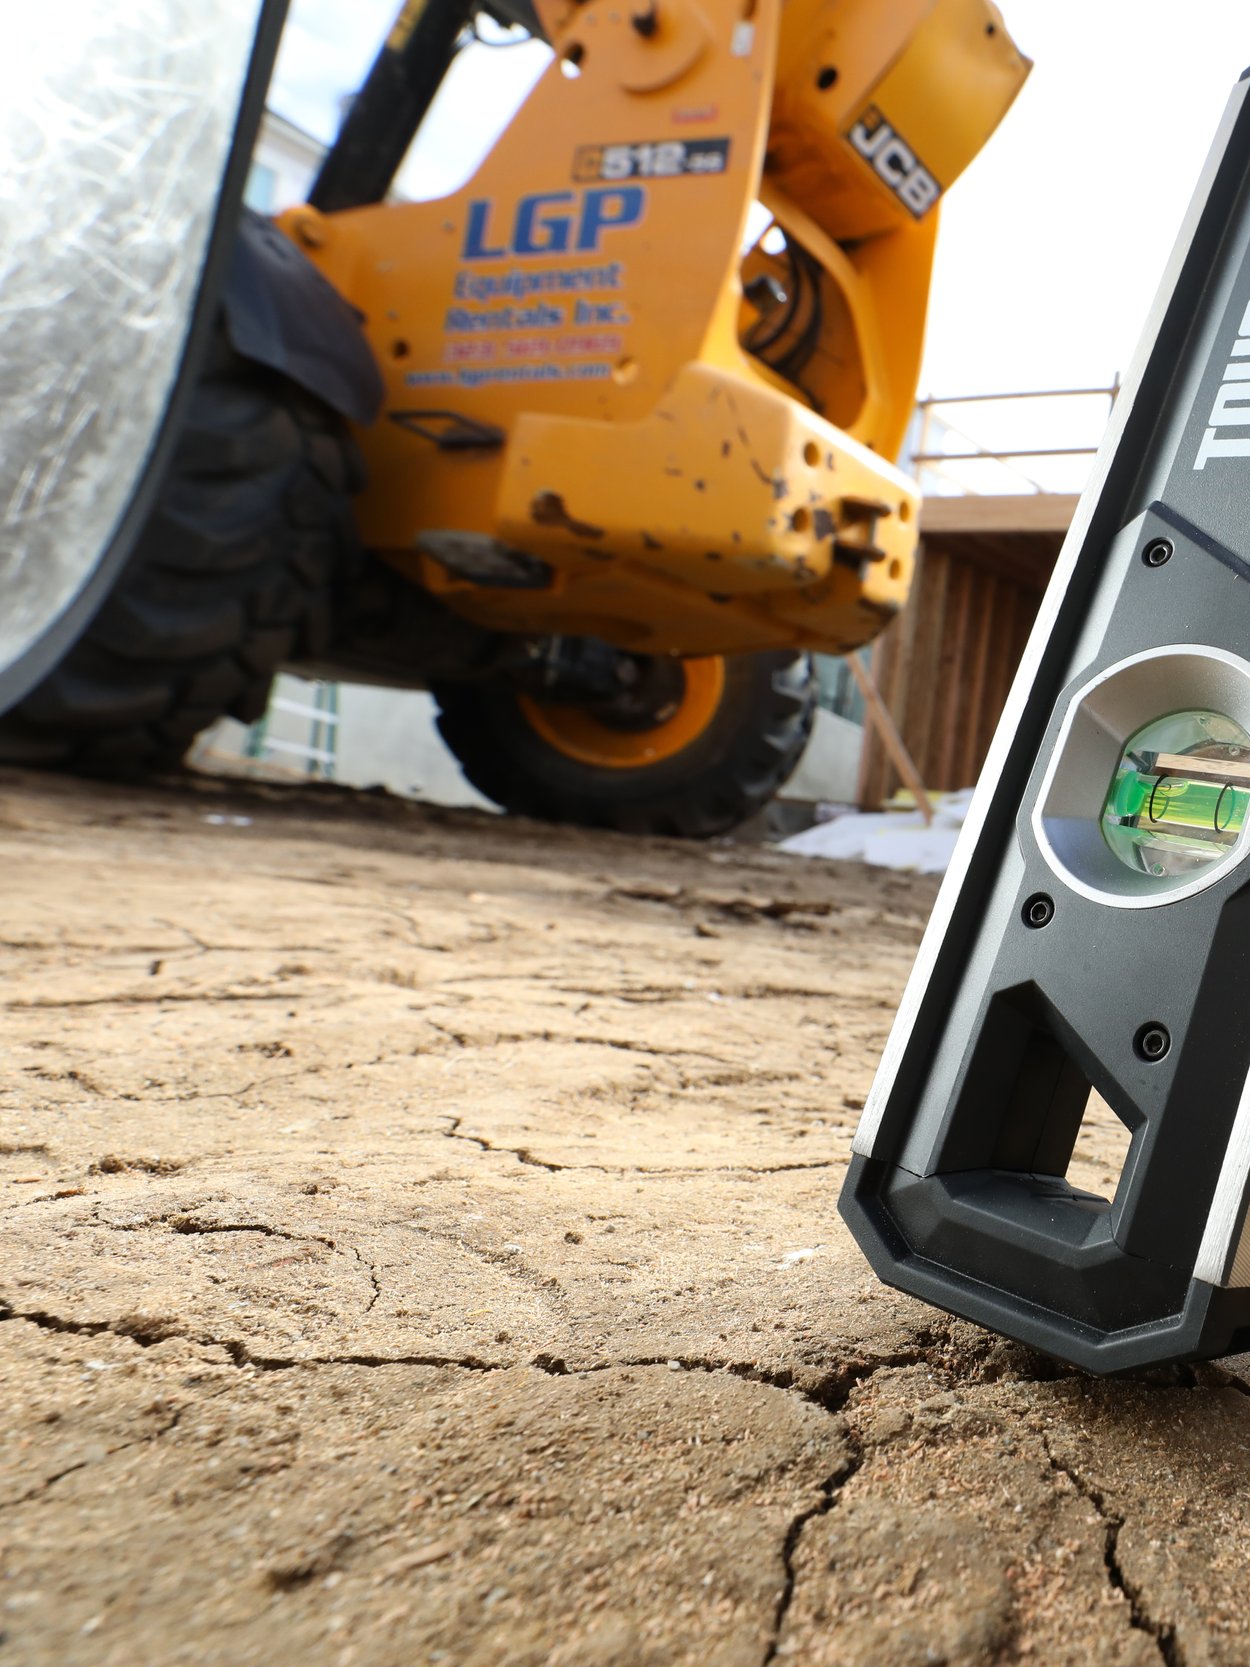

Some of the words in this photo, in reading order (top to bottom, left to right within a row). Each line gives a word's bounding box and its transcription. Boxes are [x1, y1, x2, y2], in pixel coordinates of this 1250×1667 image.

[850, 122, 940, 213] JCB
[462, 186, 645, 261] LGP
[455, 264, 622, 302] Equipment
